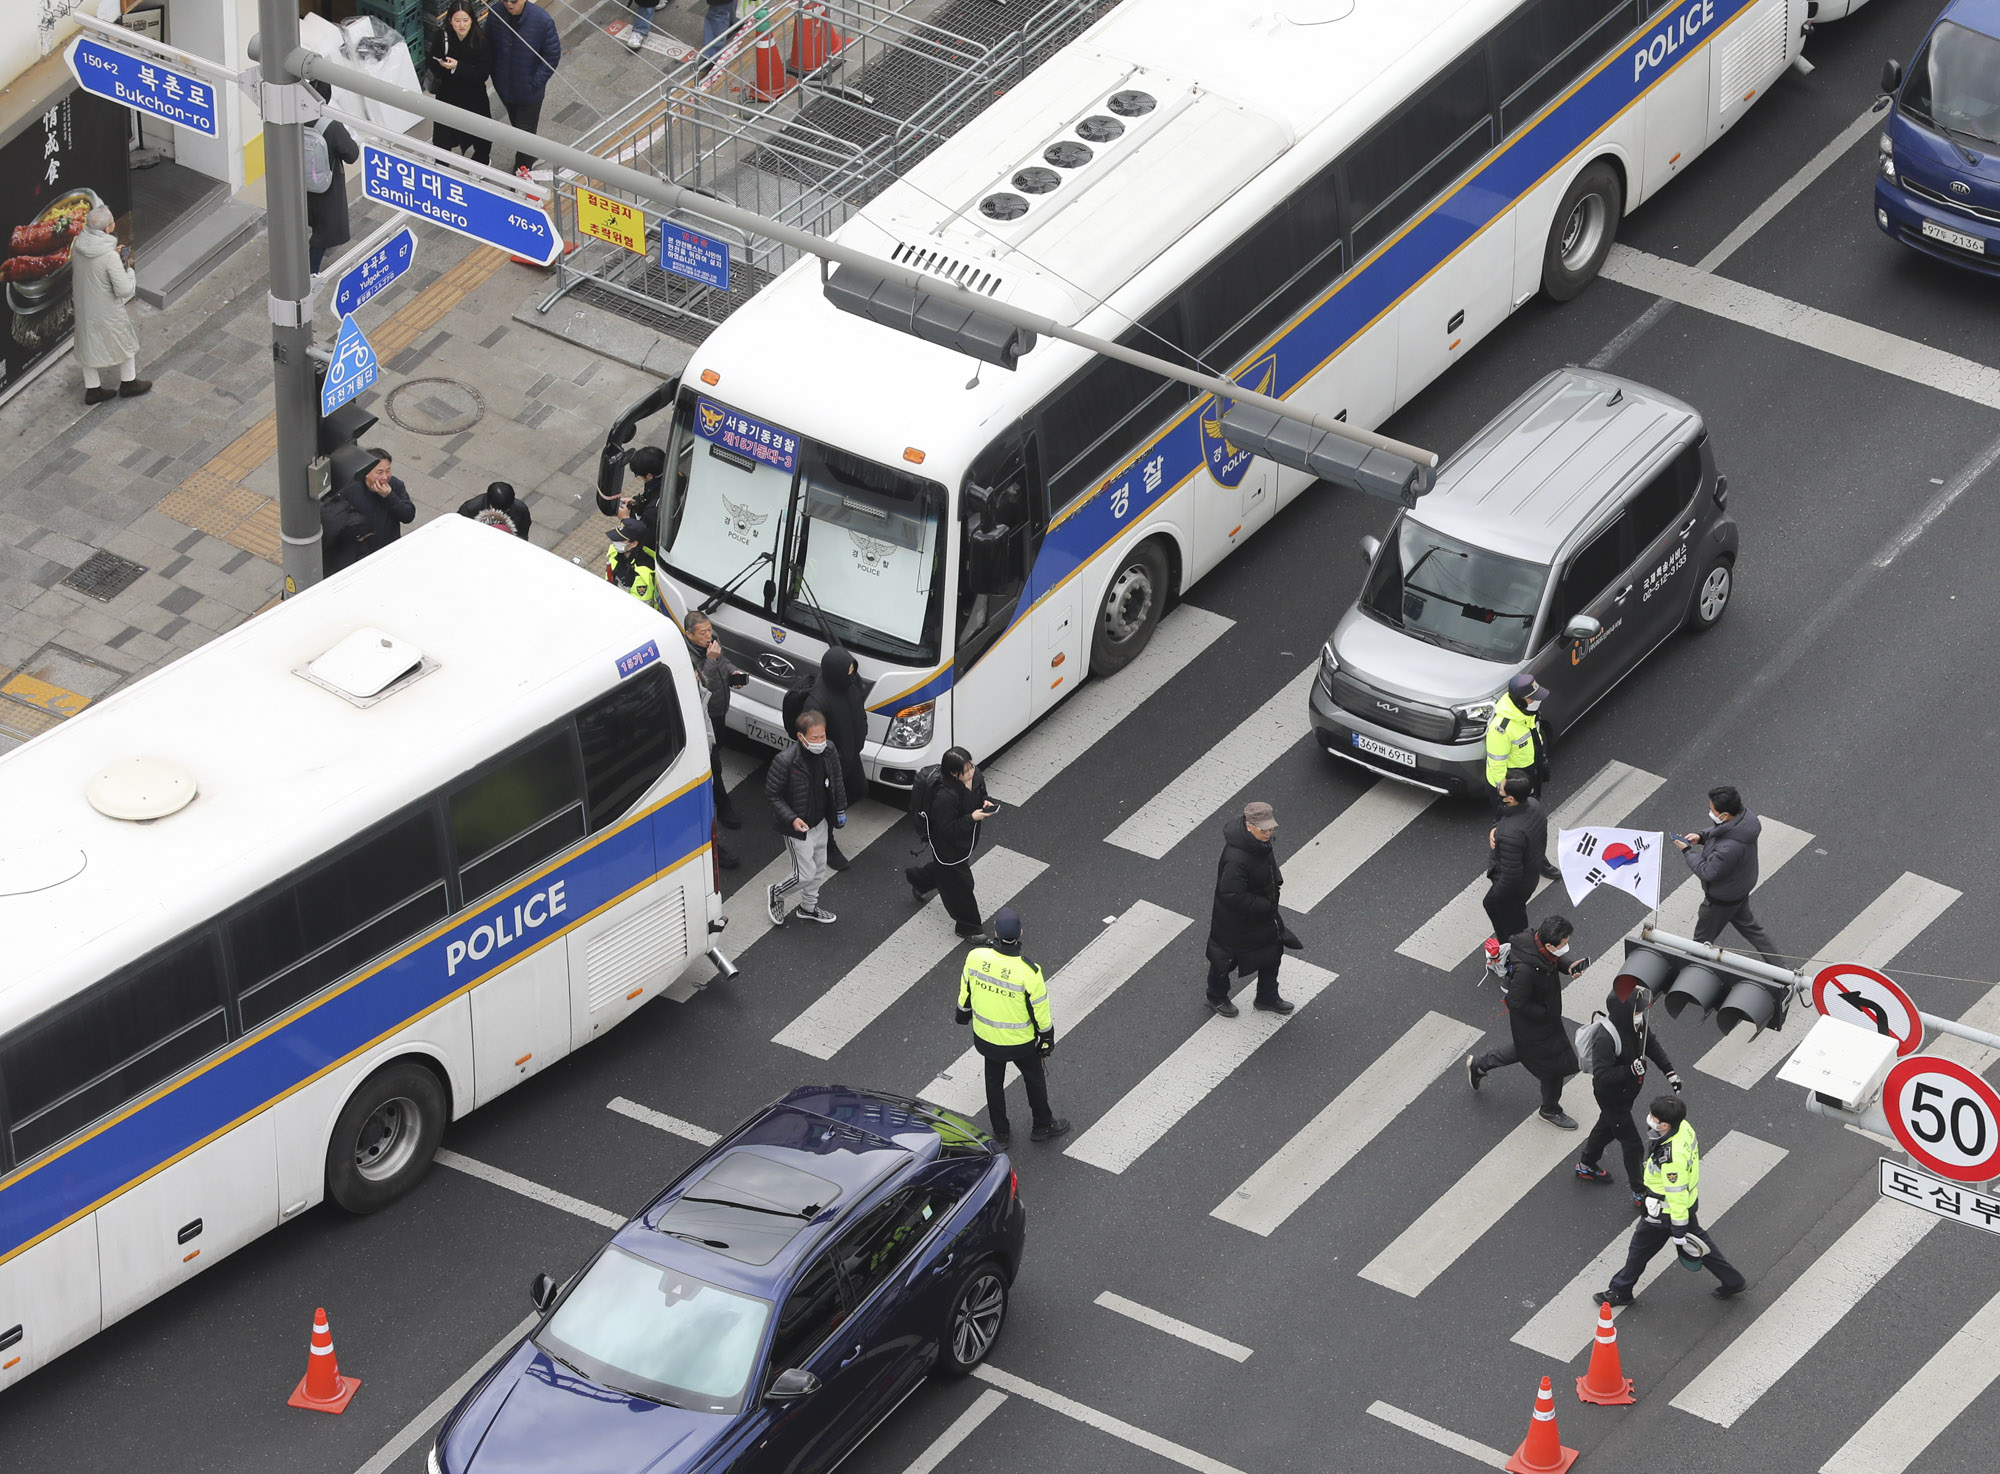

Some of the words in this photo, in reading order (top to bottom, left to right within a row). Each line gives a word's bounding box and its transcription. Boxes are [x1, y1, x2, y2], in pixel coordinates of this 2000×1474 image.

[1634, 0, 1714, 83] POLICE
[82, 52, 102, 69] 150
[137, 64, 209, 109] 북촌로
[115, 81, 211, 129] Bukchon-ro
[370, 153, 468, 207] 삼일대로
[1952, 183, 1968, 194] KIA
[370, 179, 468, 228] Samil-daero
[588, 193, 632, 220] 접근금지
[507, 214, 528, 231] 476
[590, 223, 634, 249] 추락위험
[361, 249, 388, 278] 율곡로
[399, 243, 408, 258] 67
[359, 264, 390, 291] Yulgok-ro
[340, 290, 350, 304] 63
[327, 367, 373, 409] 자전거횡단
[725, 415, 795, 454] 서울기동경찰
[1222, 449, 1251, 477] POLIC
[727, 530, 750, 546] POLICE
[857, 563, 880, 577] POLICE
[446, 879, 567, 977] POLICE
[975, 980, 1016, 999] POLICE
[1910, 1081, 1987, 1157] 50
[1888, 1171, 2000, 1225] 도심부
